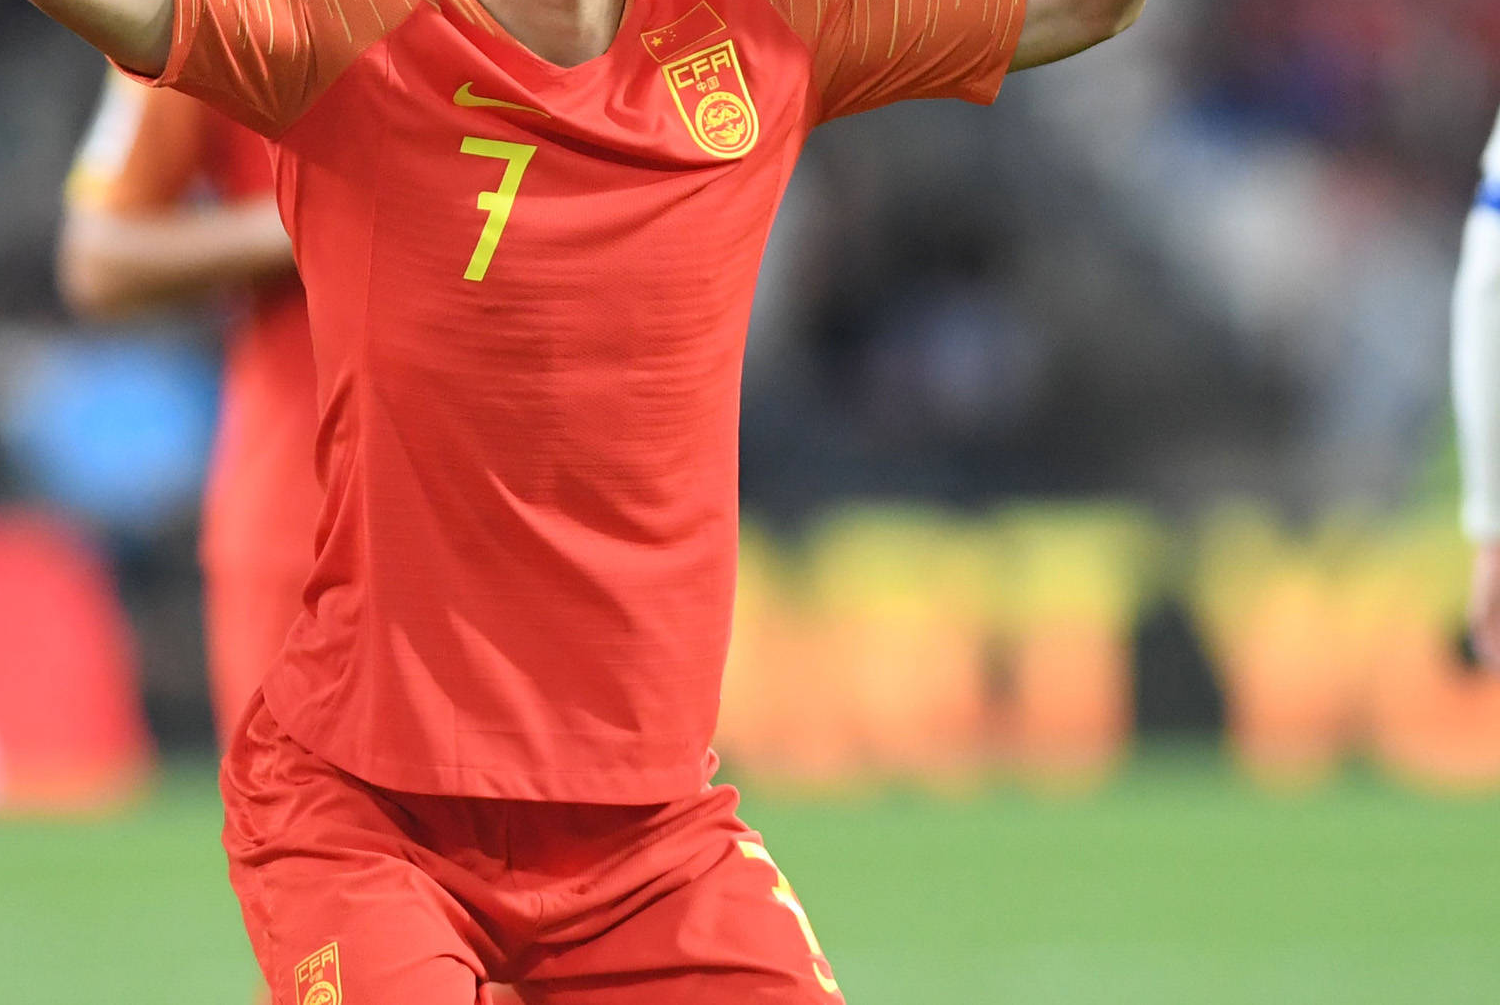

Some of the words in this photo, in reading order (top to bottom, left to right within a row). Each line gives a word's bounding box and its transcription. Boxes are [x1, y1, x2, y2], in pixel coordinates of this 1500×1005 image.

[672, 50, 732, 89] CFA
[460, 136, 538, 282] 7
[298, 948, 335, 984] CFA
